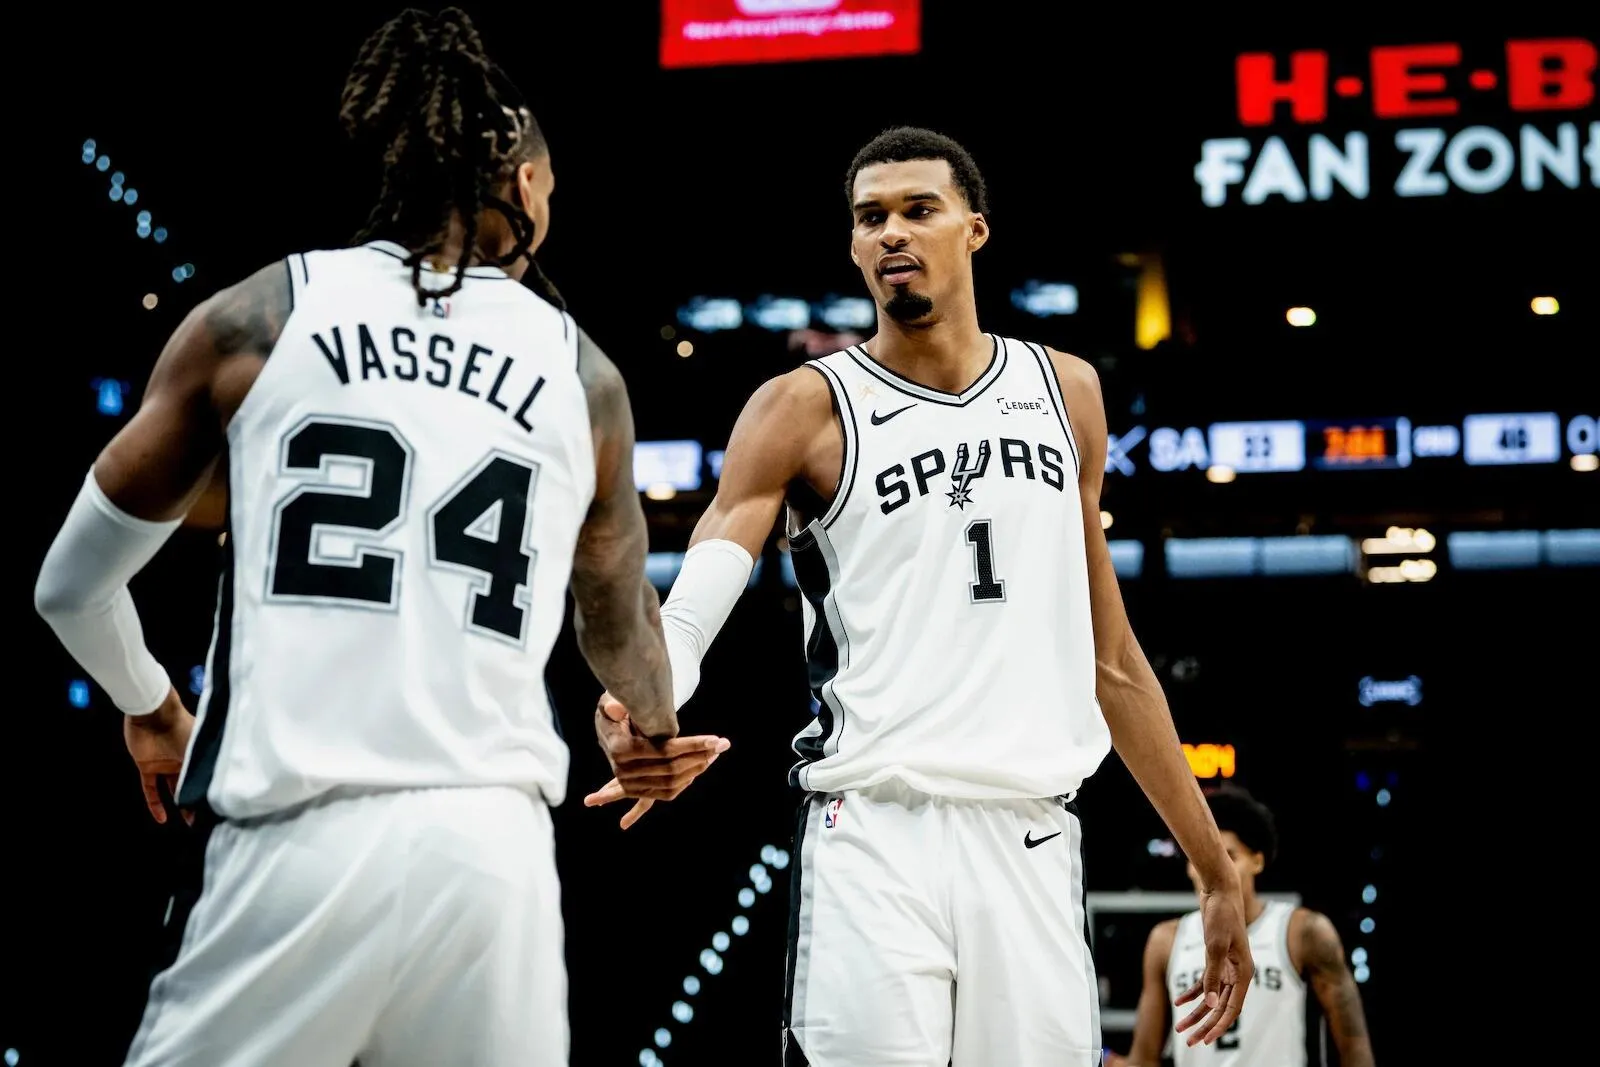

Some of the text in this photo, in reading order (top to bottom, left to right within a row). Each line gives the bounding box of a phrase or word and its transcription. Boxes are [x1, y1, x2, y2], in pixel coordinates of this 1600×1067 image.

[1194, 131, 1370, 207] FAN
[311, 323, 546, 433] VASSELL
[1005, 401, 1042, 410] LEDGER
[875, 438, 1064, 515] SPURS
[263, 413, 541, 652] 24
[964, 518, 1007, 604] 1
